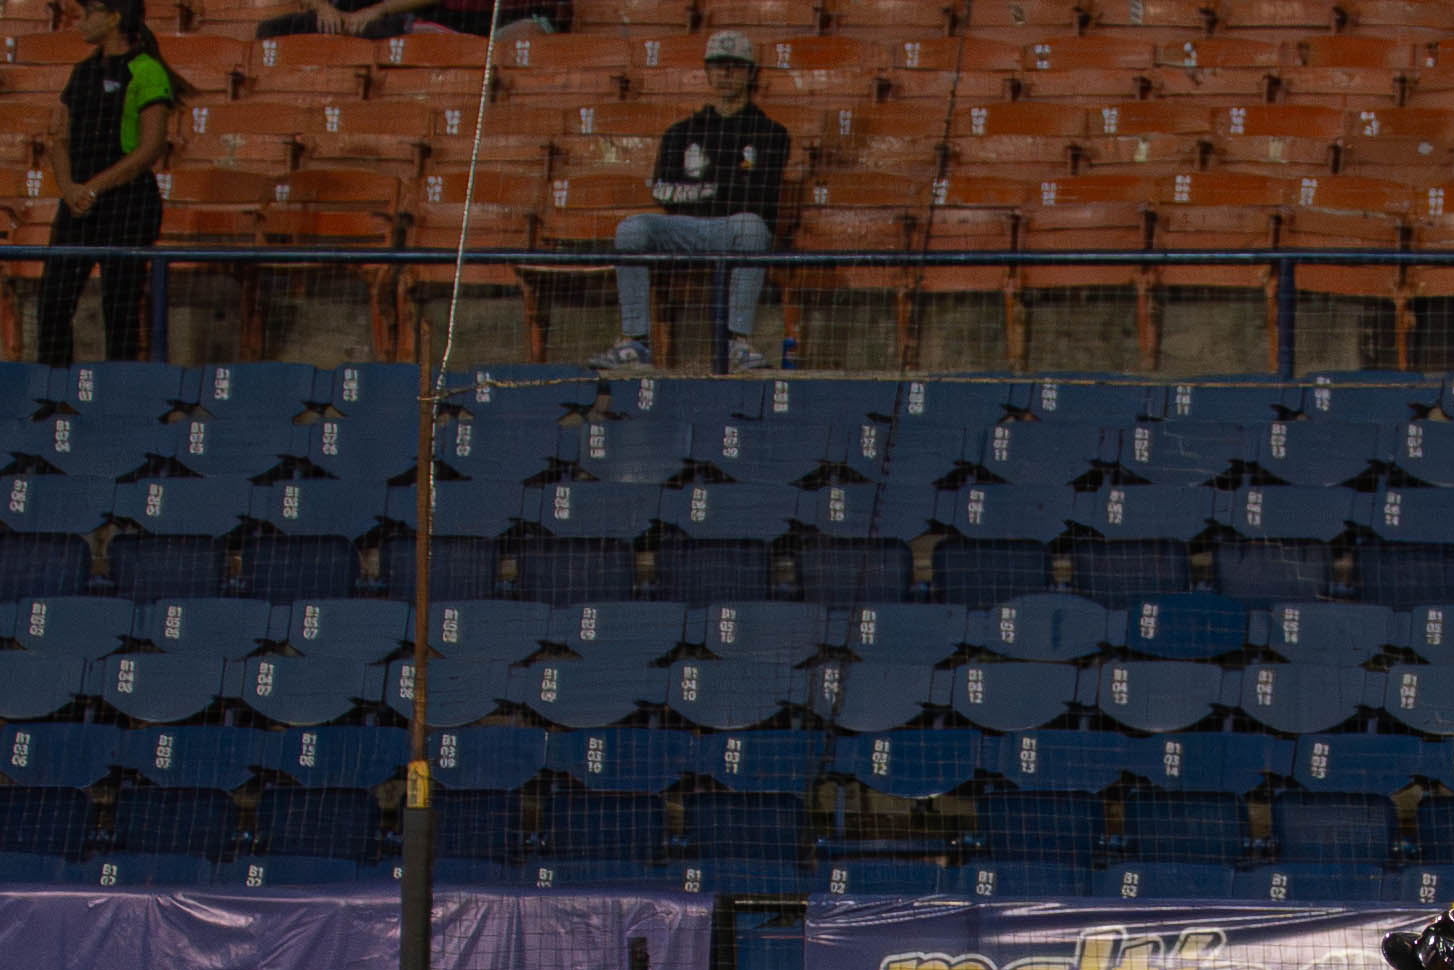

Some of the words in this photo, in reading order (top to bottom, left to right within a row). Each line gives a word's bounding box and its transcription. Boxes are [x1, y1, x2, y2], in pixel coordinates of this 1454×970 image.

[685, 882, 699, 892] 02
[831, 882, 845, 891] 02
[976, 884, 992, 894] 02
[1122, 885, 1137, 896] 02
[1420, 886, 1435, 897] 02
[1270, 887, 1286, 897] 02
